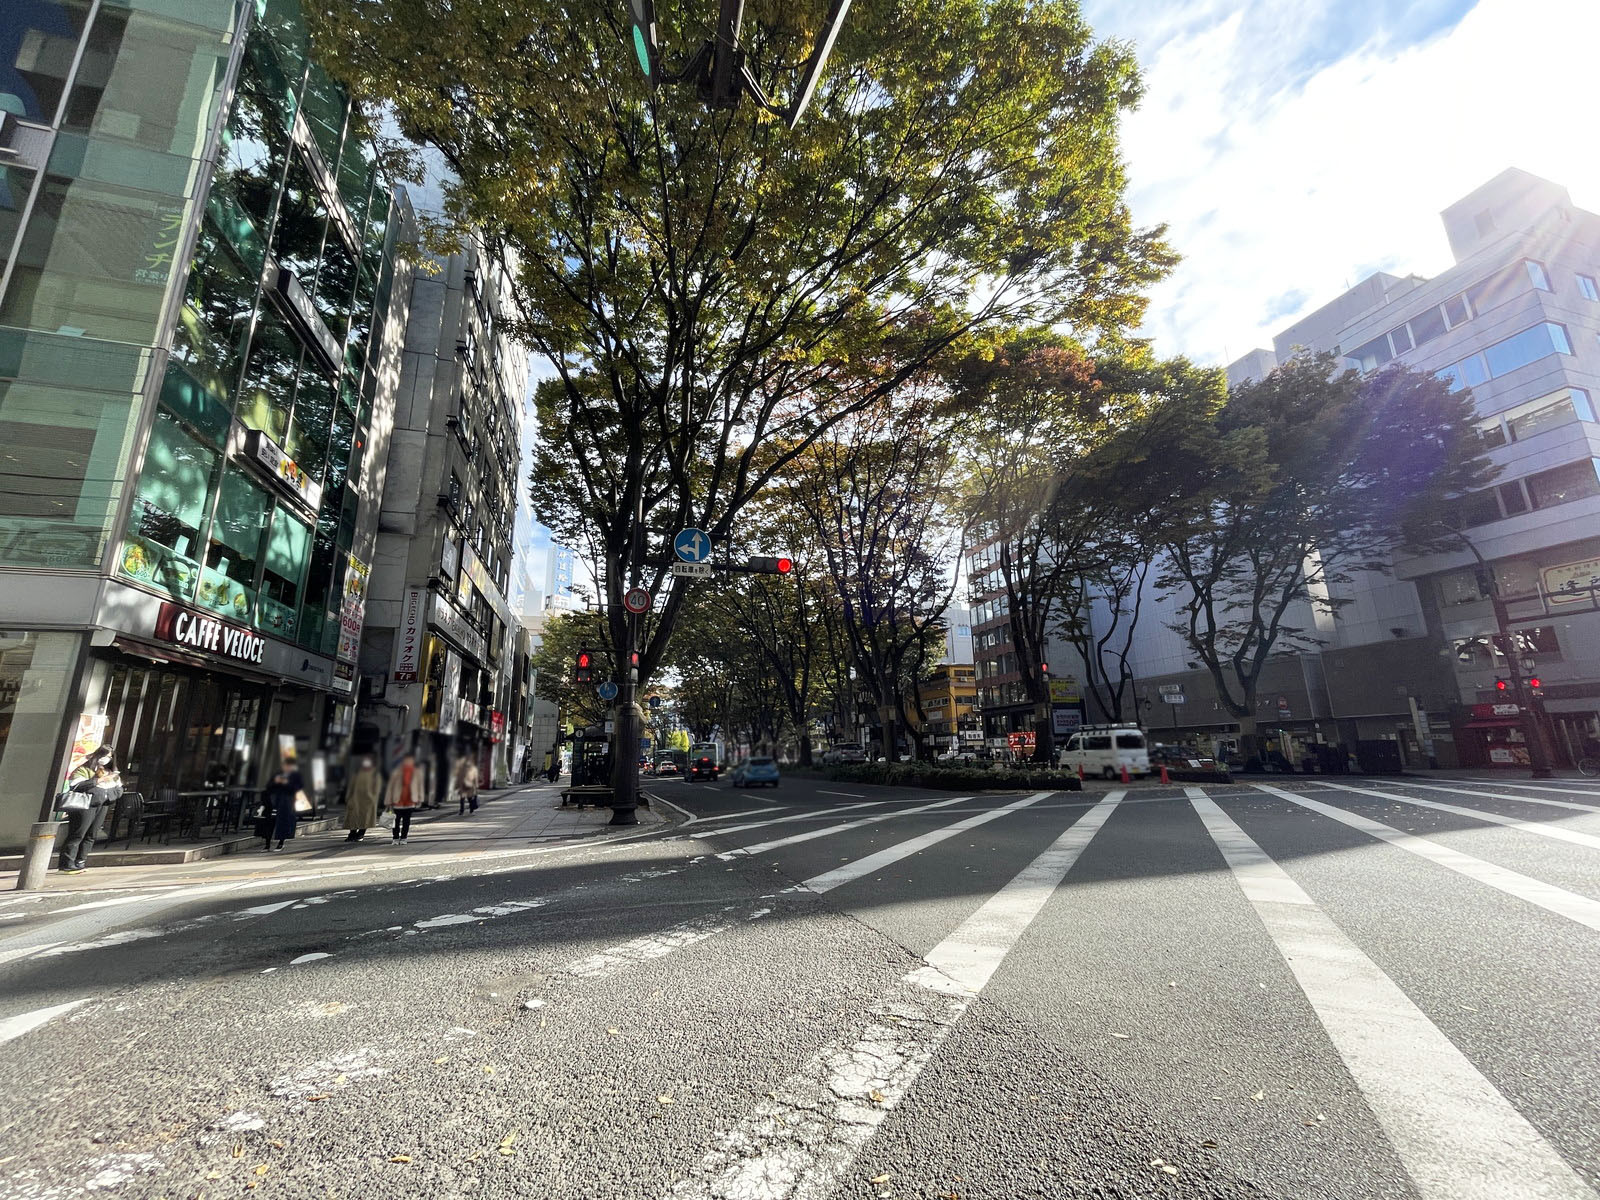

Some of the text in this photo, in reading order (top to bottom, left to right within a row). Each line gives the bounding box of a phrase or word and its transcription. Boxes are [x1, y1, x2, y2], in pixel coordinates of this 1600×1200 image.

[675, 565, 709, 575] 自転車を除く
[630, 595, 645, 606] 40
[224, 626, 265, 663] VELOCE
[403, 627, 416, 662] カラオケ
[400, 672, 412, 680] 7F
